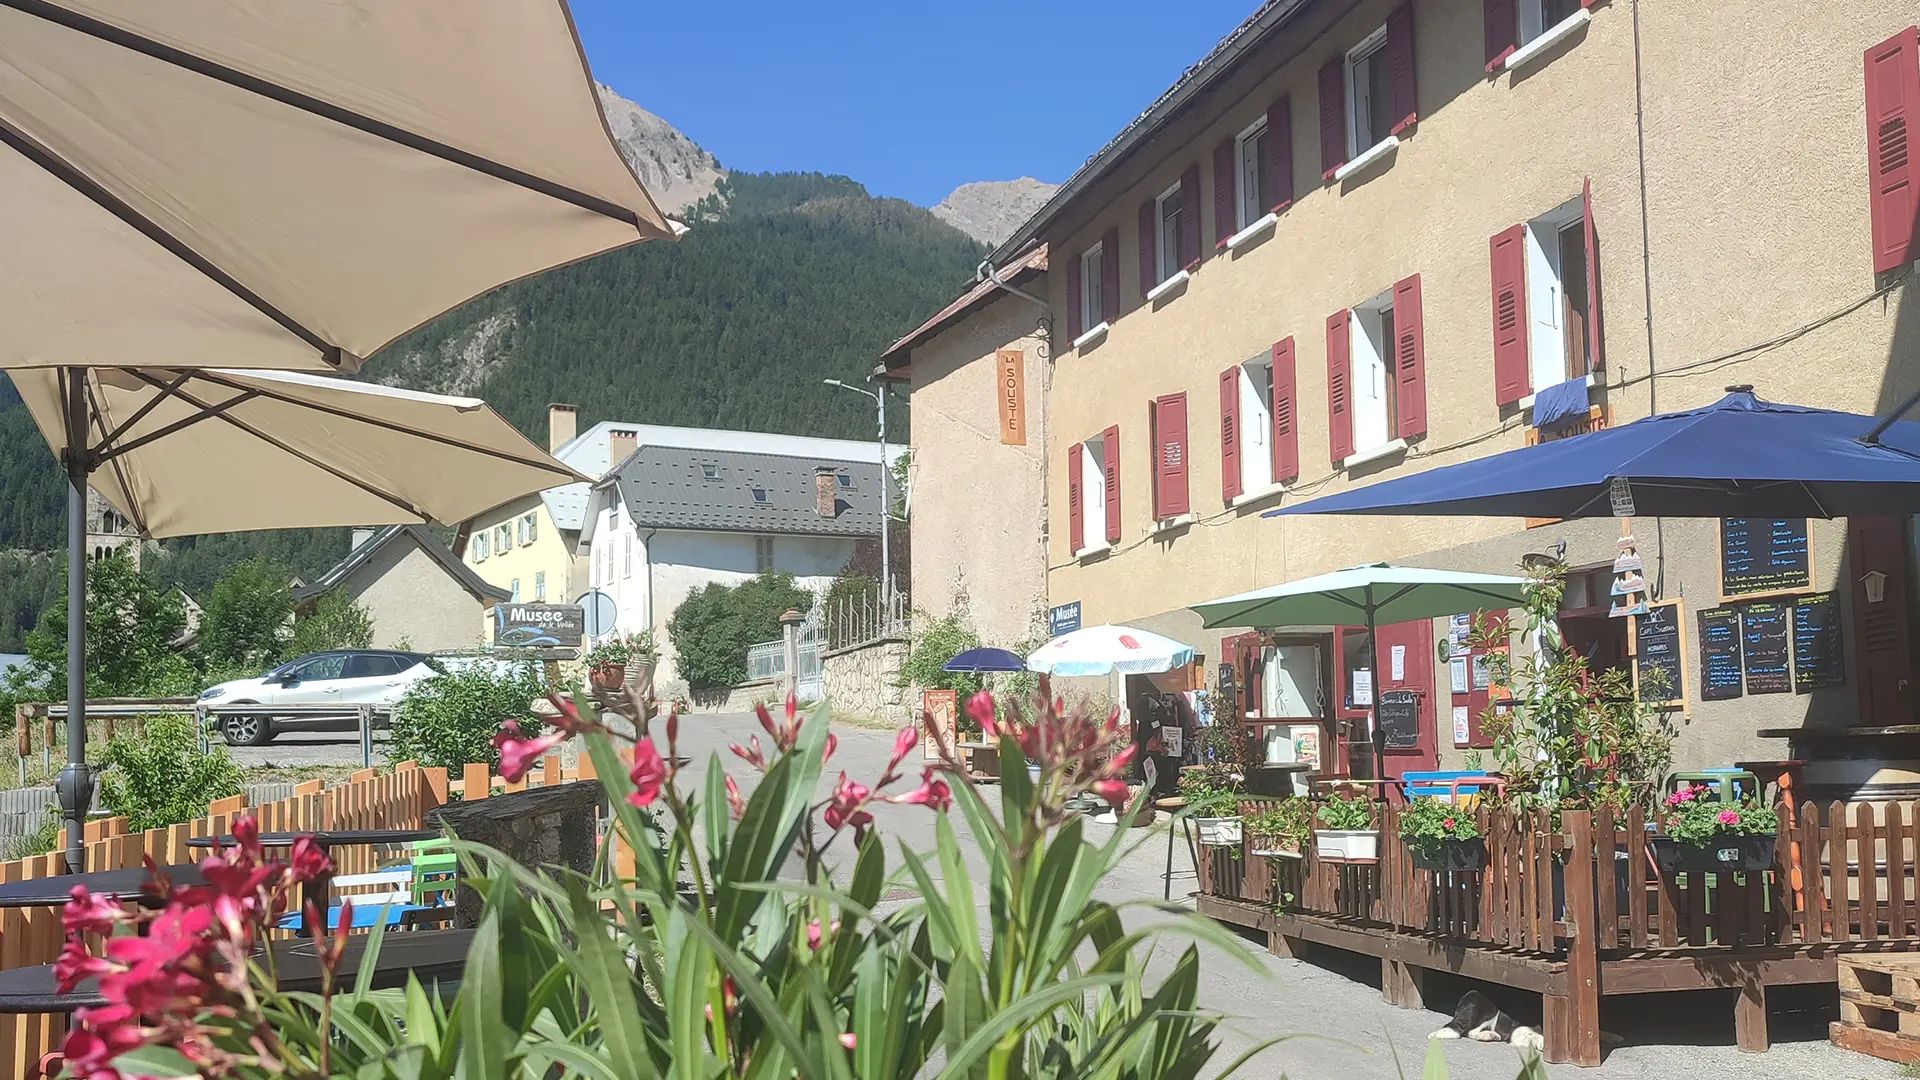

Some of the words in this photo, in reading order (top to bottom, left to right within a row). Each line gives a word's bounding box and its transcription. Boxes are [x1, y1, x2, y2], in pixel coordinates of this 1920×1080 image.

[1007, 368, 1017, 430] SOUSTE
[510, 607, 564, 621] Musée
[1056, 604, 1078, 621] Musée
